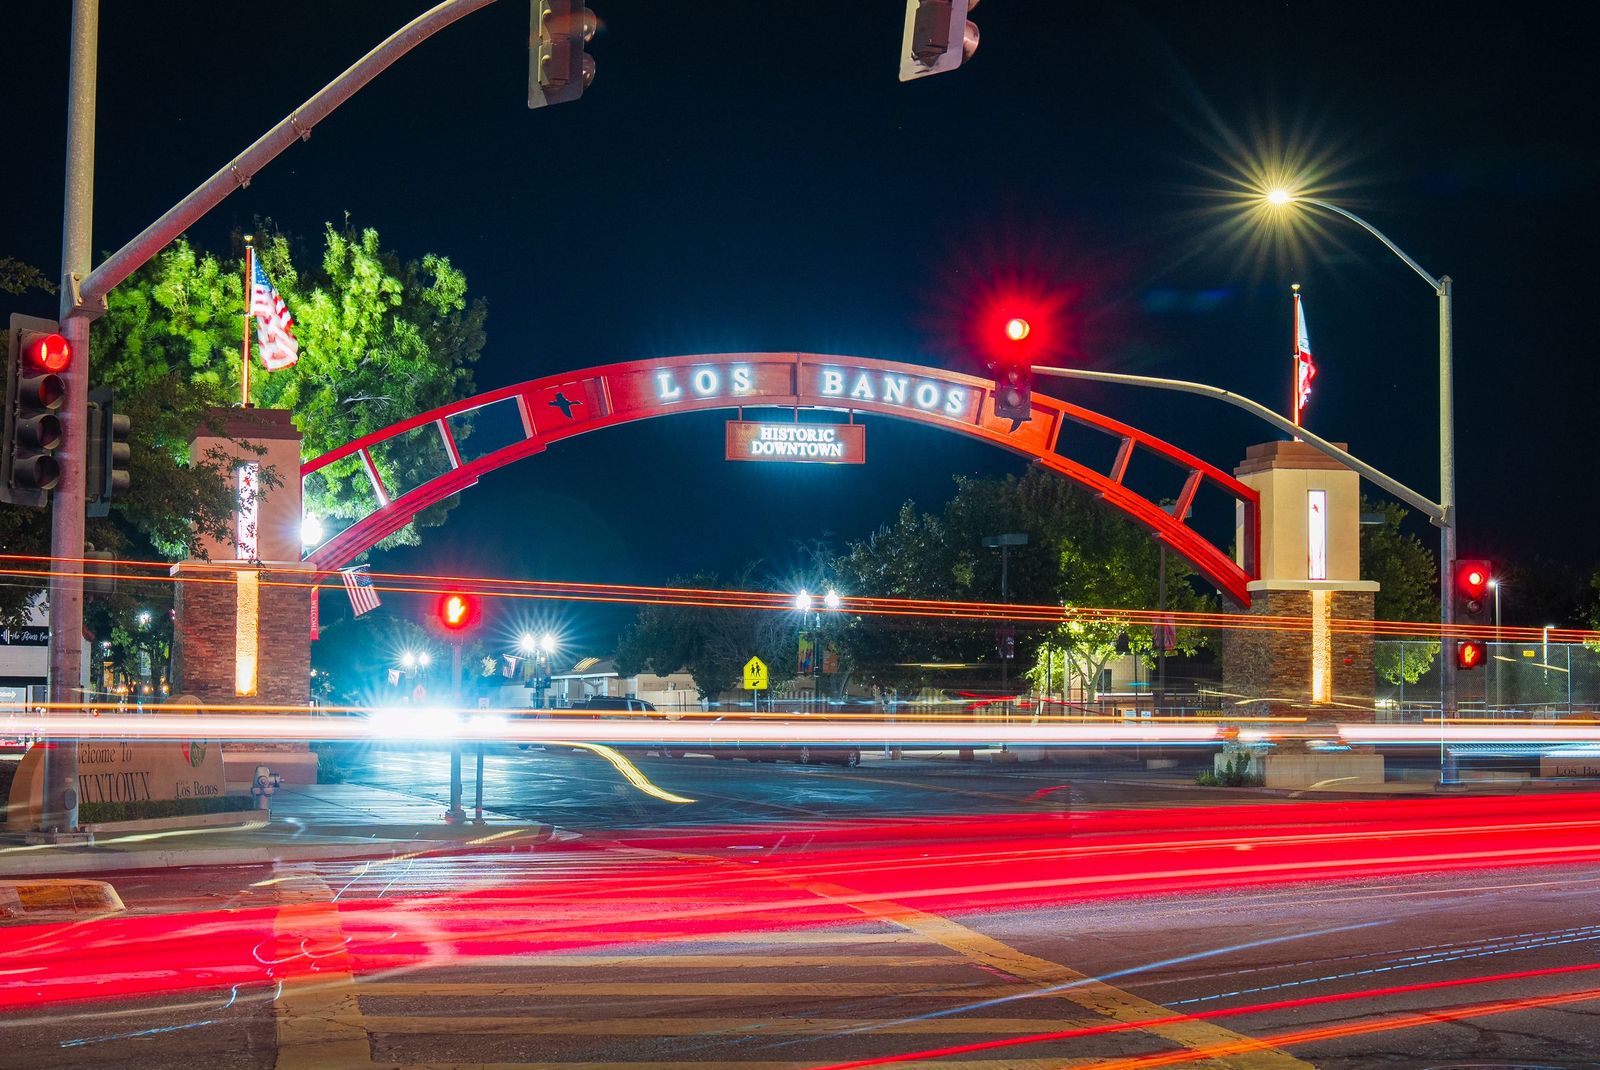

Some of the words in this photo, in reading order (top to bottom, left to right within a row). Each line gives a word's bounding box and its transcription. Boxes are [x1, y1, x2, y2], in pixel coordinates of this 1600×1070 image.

[657, 368, 752, 399] LOS
[822, 371, 964, 414] BANOS
[760, 427, 835, 443] HISTORIC
[751, 442, 843, 458] DOWNTOWN
[120, 741, 133, 762] To
[1556, 766, 1577, 777] Los
[78, 771, 151, 805] WNTOWN
[175, 782, 191, 799] Los
[193, 780, 219, 796] Banos
